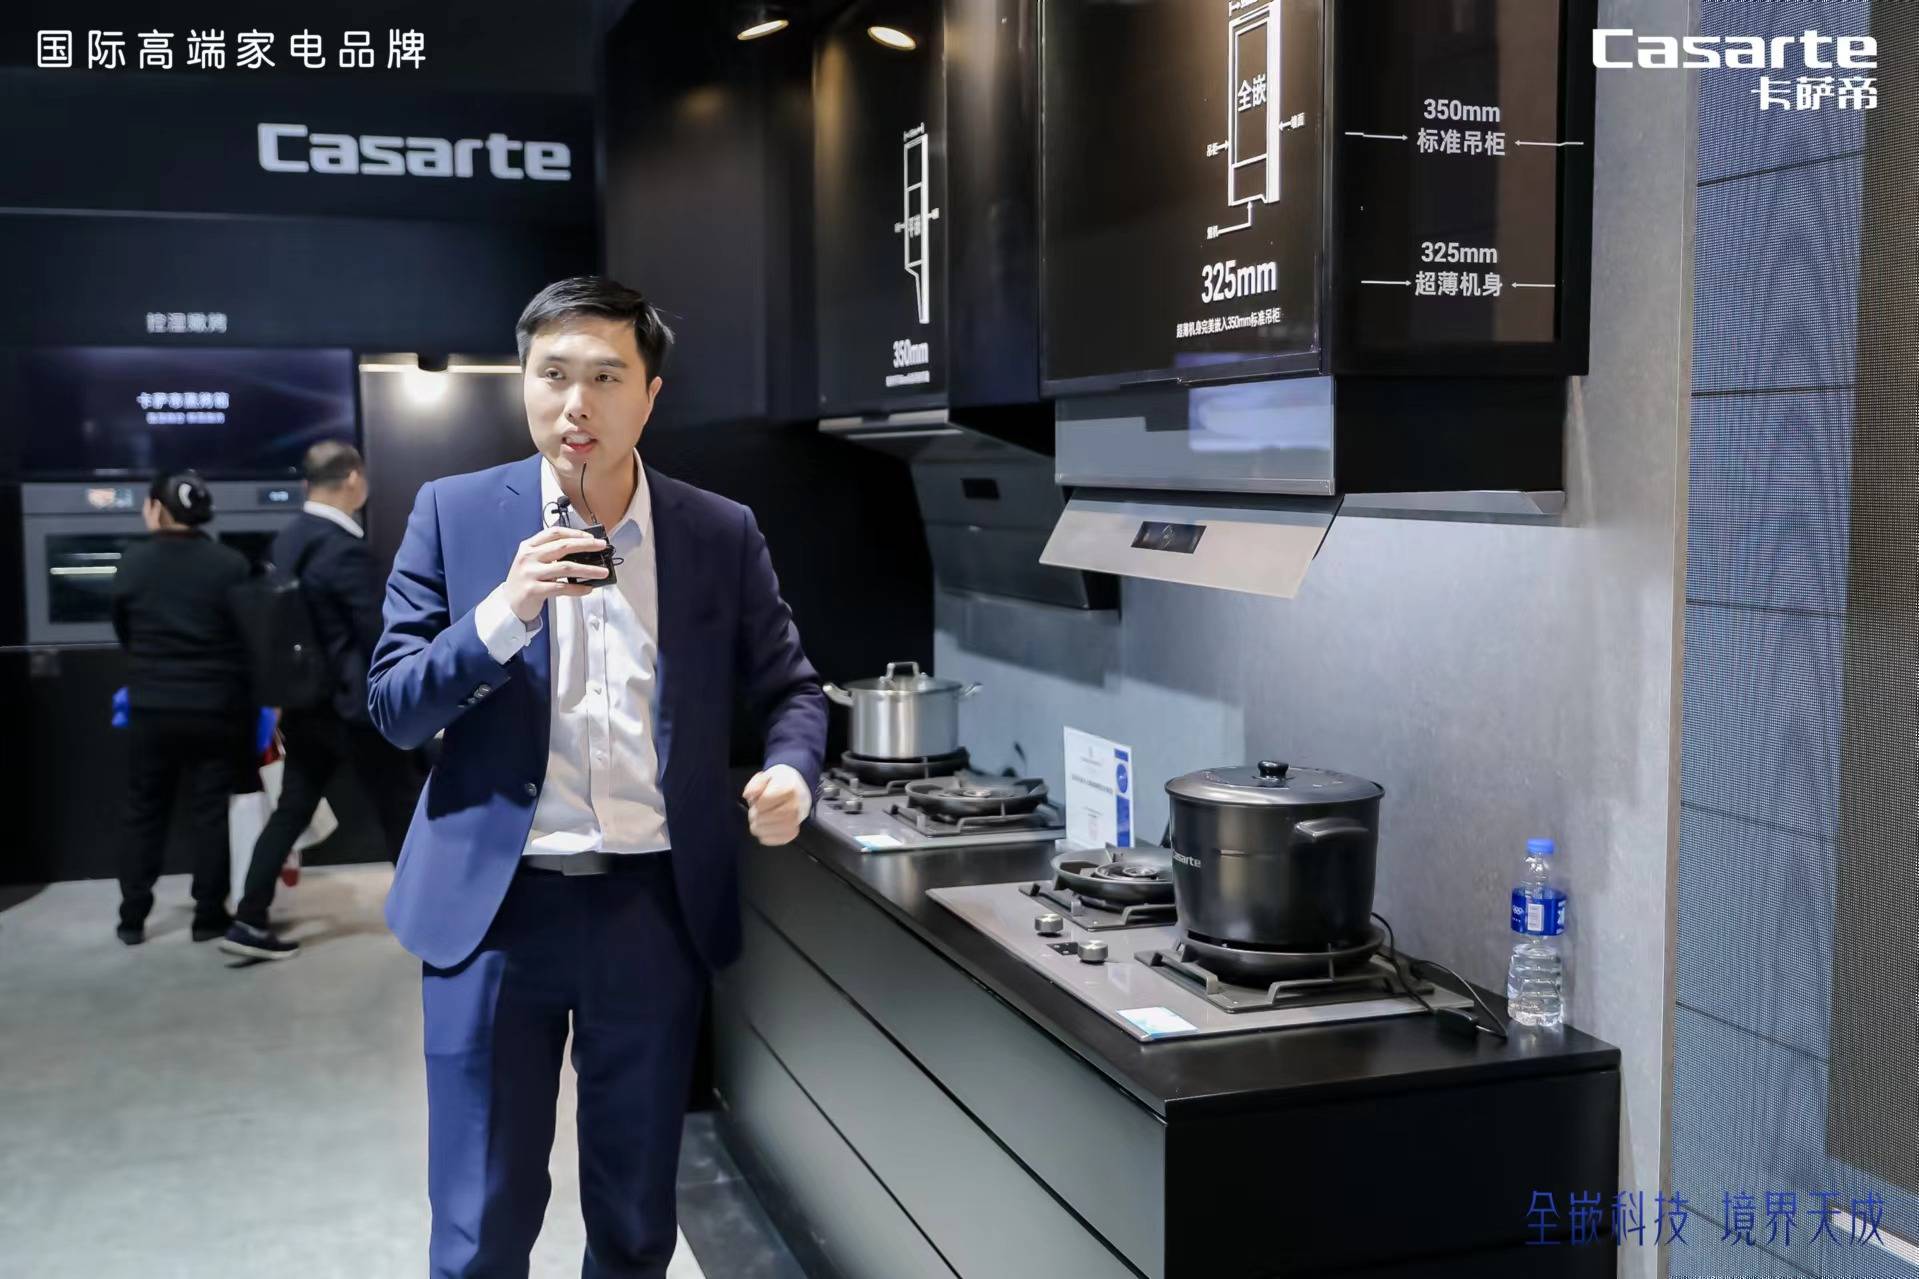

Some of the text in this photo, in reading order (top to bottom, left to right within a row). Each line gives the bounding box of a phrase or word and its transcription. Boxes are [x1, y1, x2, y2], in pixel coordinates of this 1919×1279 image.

[1237, 73, 1267, 112] 全嵌
[1423, 98, 1501, 123] 350mm
[257, 122, 571, 181] Casarte
[1416, 127, 1506, 157] 标准吊柜
[1420, 241, 1499, 264] 325mm
[1201, 259, 1277, 304] 325mm
[1414, 270, 1504, 298] 超薄机身
